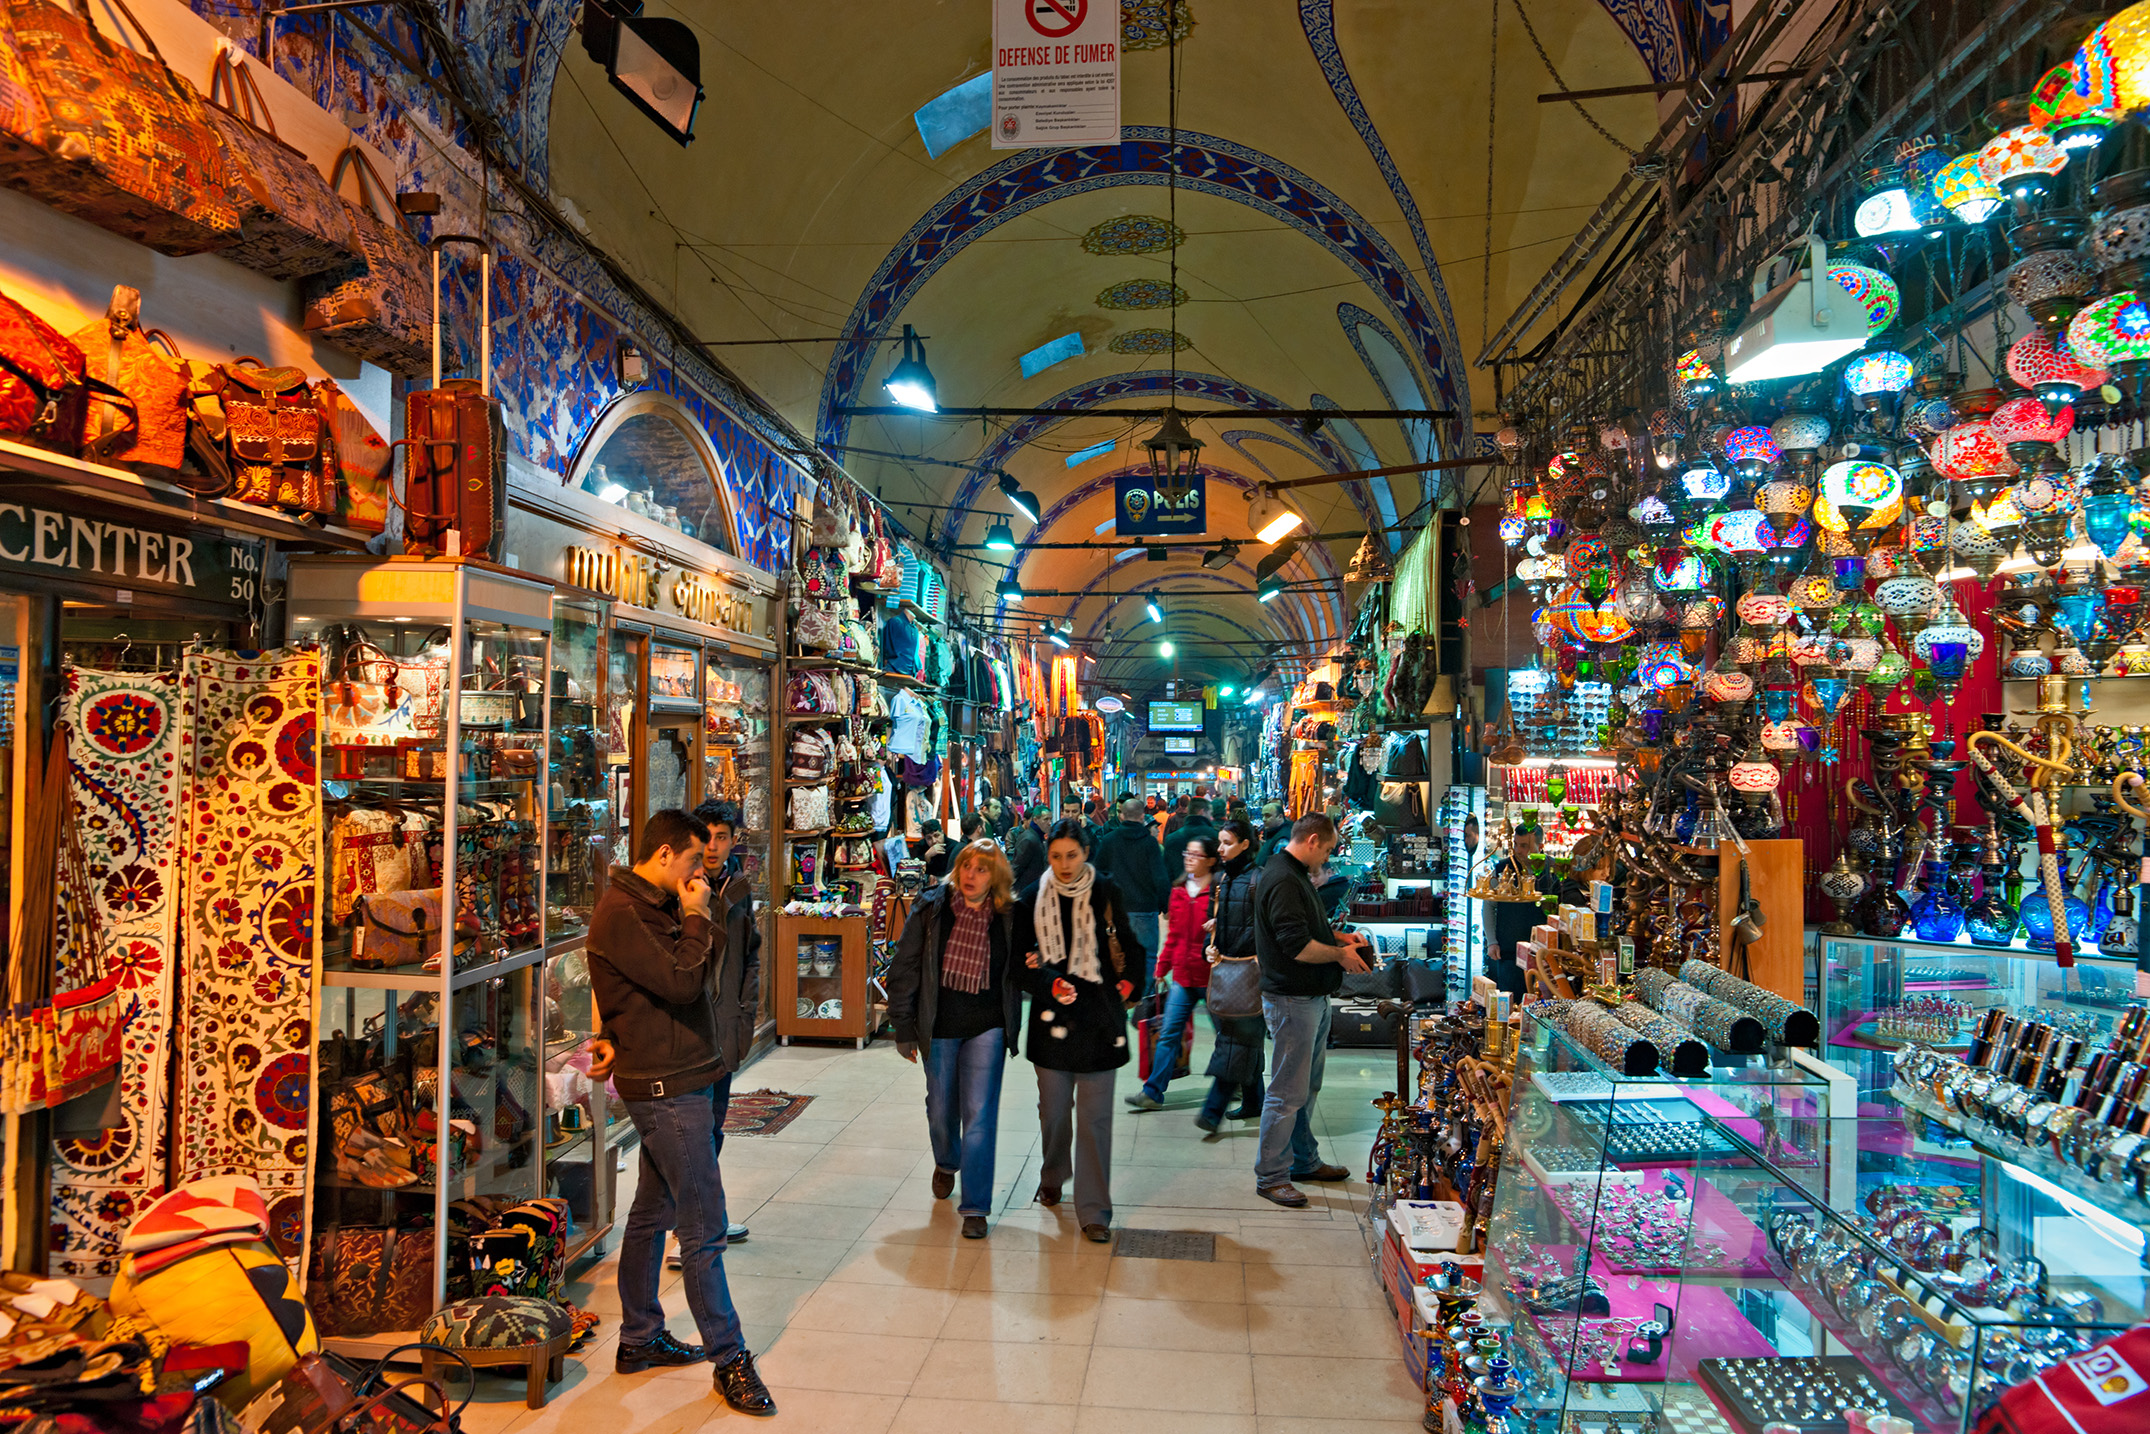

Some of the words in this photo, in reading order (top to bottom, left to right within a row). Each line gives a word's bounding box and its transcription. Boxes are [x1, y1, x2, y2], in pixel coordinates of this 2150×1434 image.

[999, 46, 1051, 67] DEFENSE
[1055, 45, 1070, 65] DE
[1074, 43, 1115, 63] FUMER
[0, 503, 196, 587] CENTER
[231, 546, 259, 572] No.
[230, 577, 254, 600] 50
